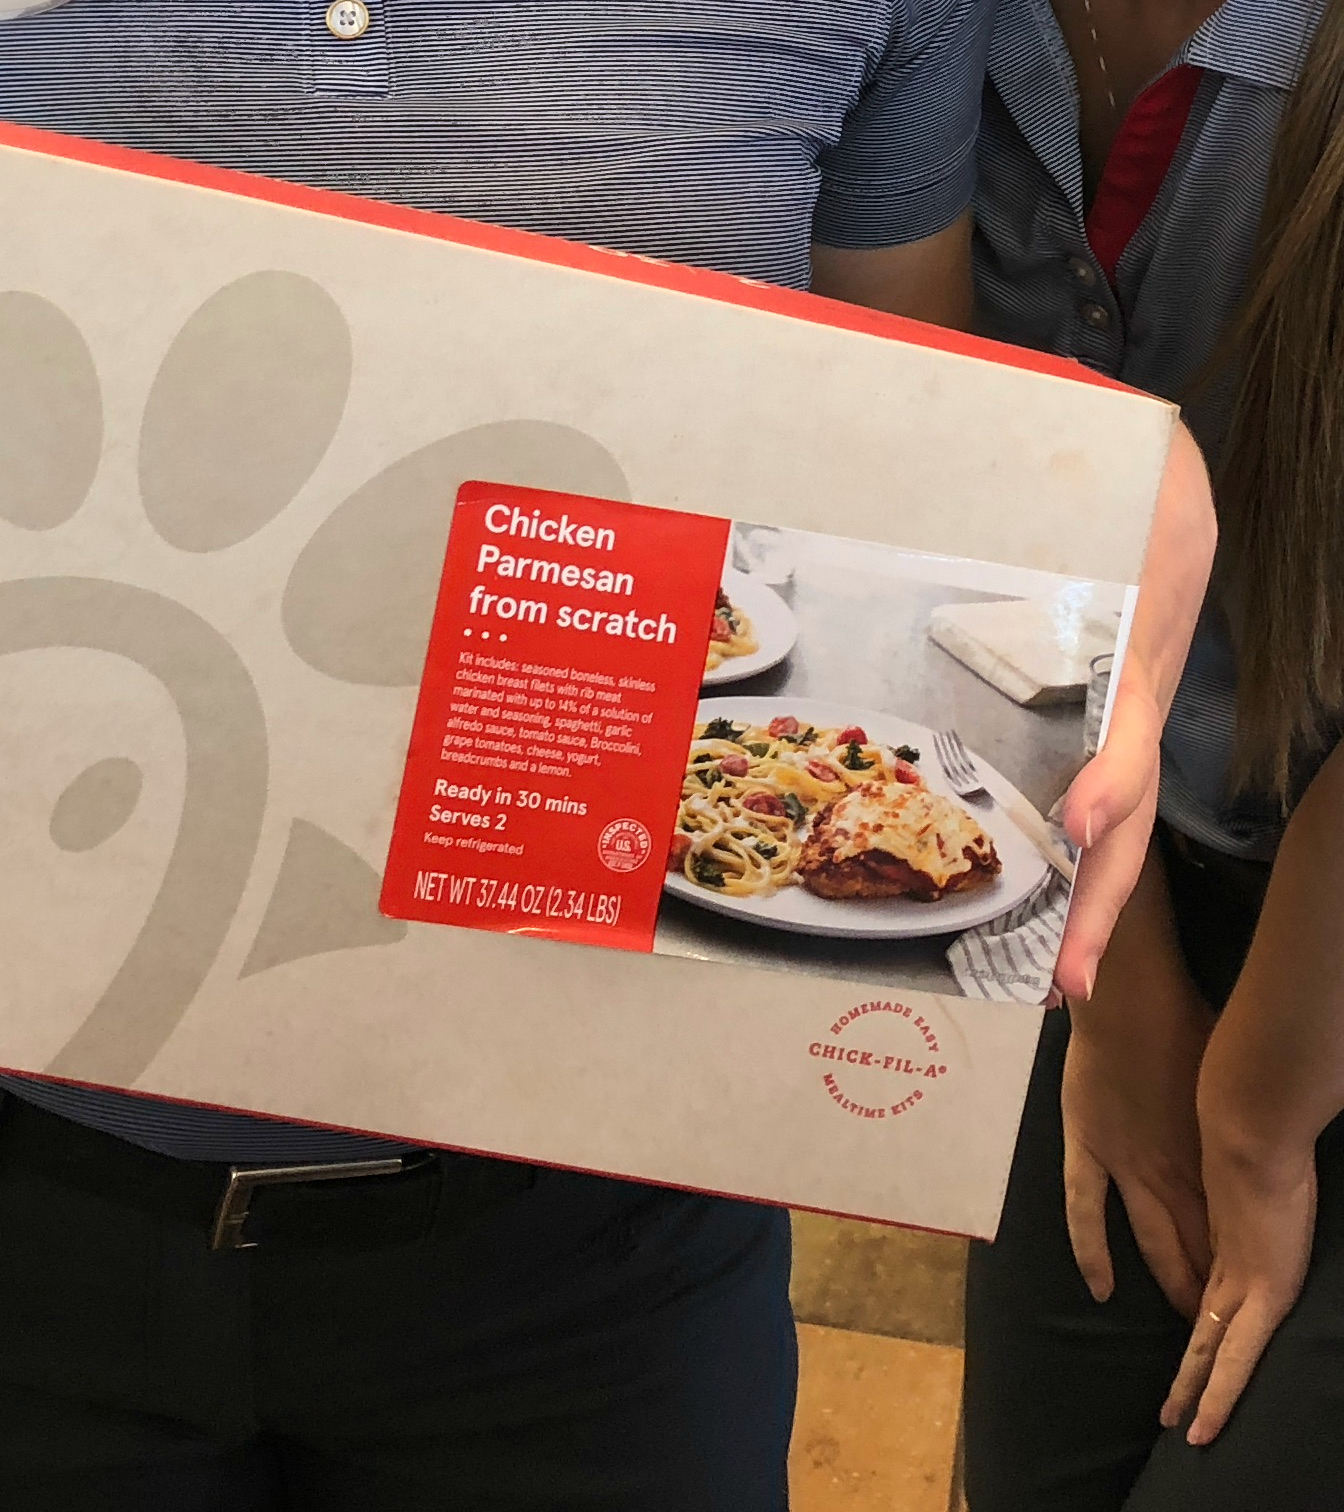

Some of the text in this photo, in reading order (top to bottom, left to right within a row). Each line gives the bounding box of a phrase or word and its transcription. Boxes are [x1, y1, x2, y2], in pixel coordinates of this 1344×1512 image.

[484, 504, 616, 551] Chicken
[476, 544, 634, 596] Parmesan
[469, 586, 677, 644] from scratch
[455, 668, 622, 704] chicken breast filets with rib meat
[459, 651, 656, 692] Kit includes: seasoned boneless, skinless
[450, 701, 633, 738] water and seasoning, spaghetti, garlic
[452, 686, 654, 724] marinated with up to 14% of a solution of
[442, 734, 602, 767] grape tomatoes, cheese, yogurt,
[446, 717, 642, 756] alfredo sauce, tomato sauce, Broccolini,
[440, 748, 572, 778] breadcrumbs and a lemon.
[433, 779, 588, 816] Ready in 30 mins
[429, 804, 508, 831] Serves 2
[601, 821, 649, 849] INSPECTED
[423, 831, 525, 856] Keep refrigerated
[413, 870, 623, 927] NET WT 37.44 OZ (2.34 LBS)
[829, 1000, 940, 1053] HOMEMADE EASY
[823, 1072, 924, 1119] MEALTIME KITS
